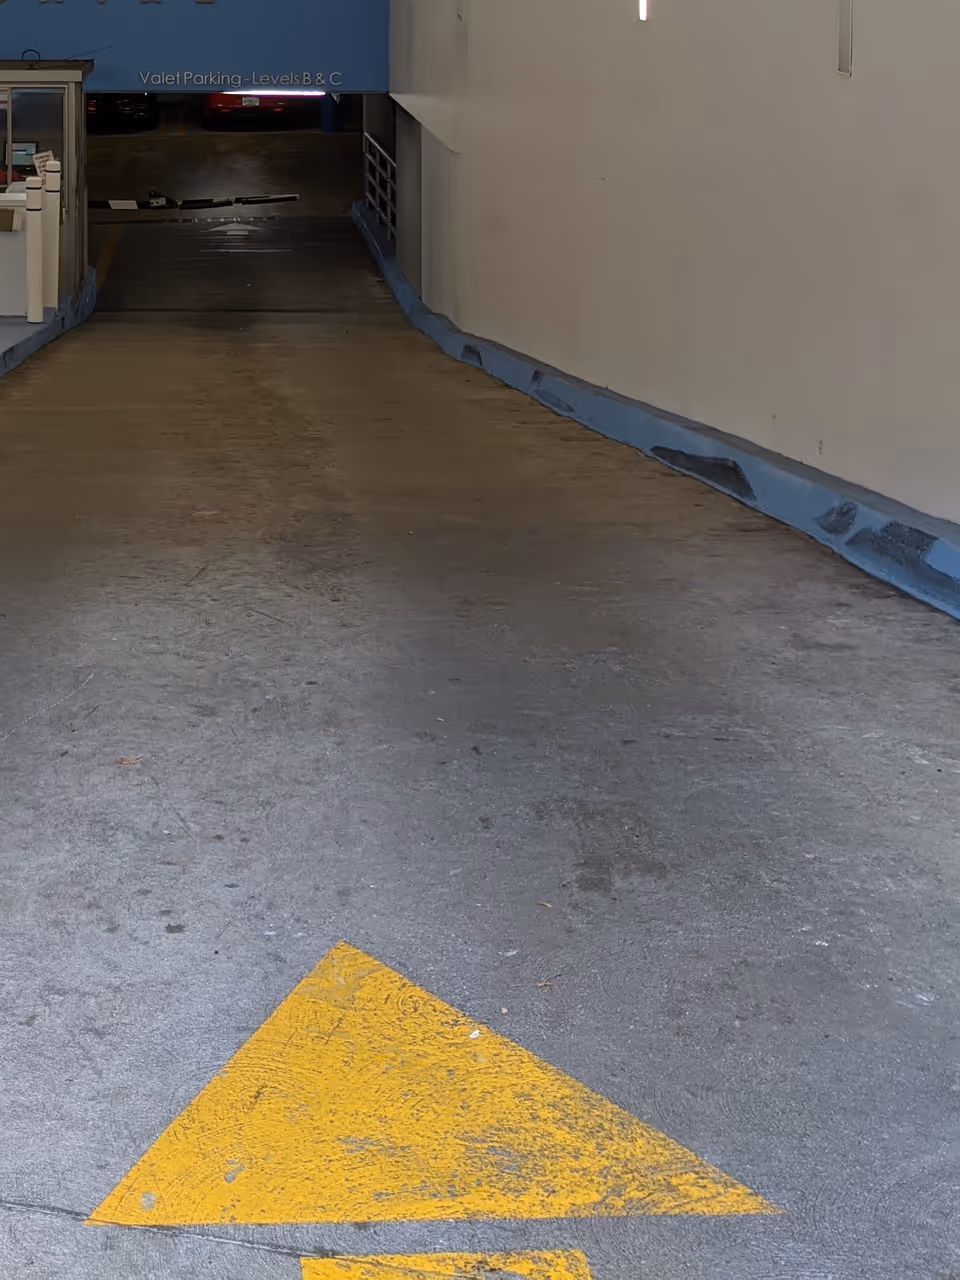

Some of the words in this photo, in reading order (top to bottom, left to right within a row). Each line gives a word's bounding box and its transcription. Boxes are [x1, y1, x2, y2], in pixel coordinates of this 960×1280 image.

[140, 71, 180, 86] Valet
[184, 71, 241, 88] Parking
[253, 71, 300, 86] Levels
[302, 72, 312, 86] B
[315, 72, 326, 86] &
[329, 72, 342, 86] C
